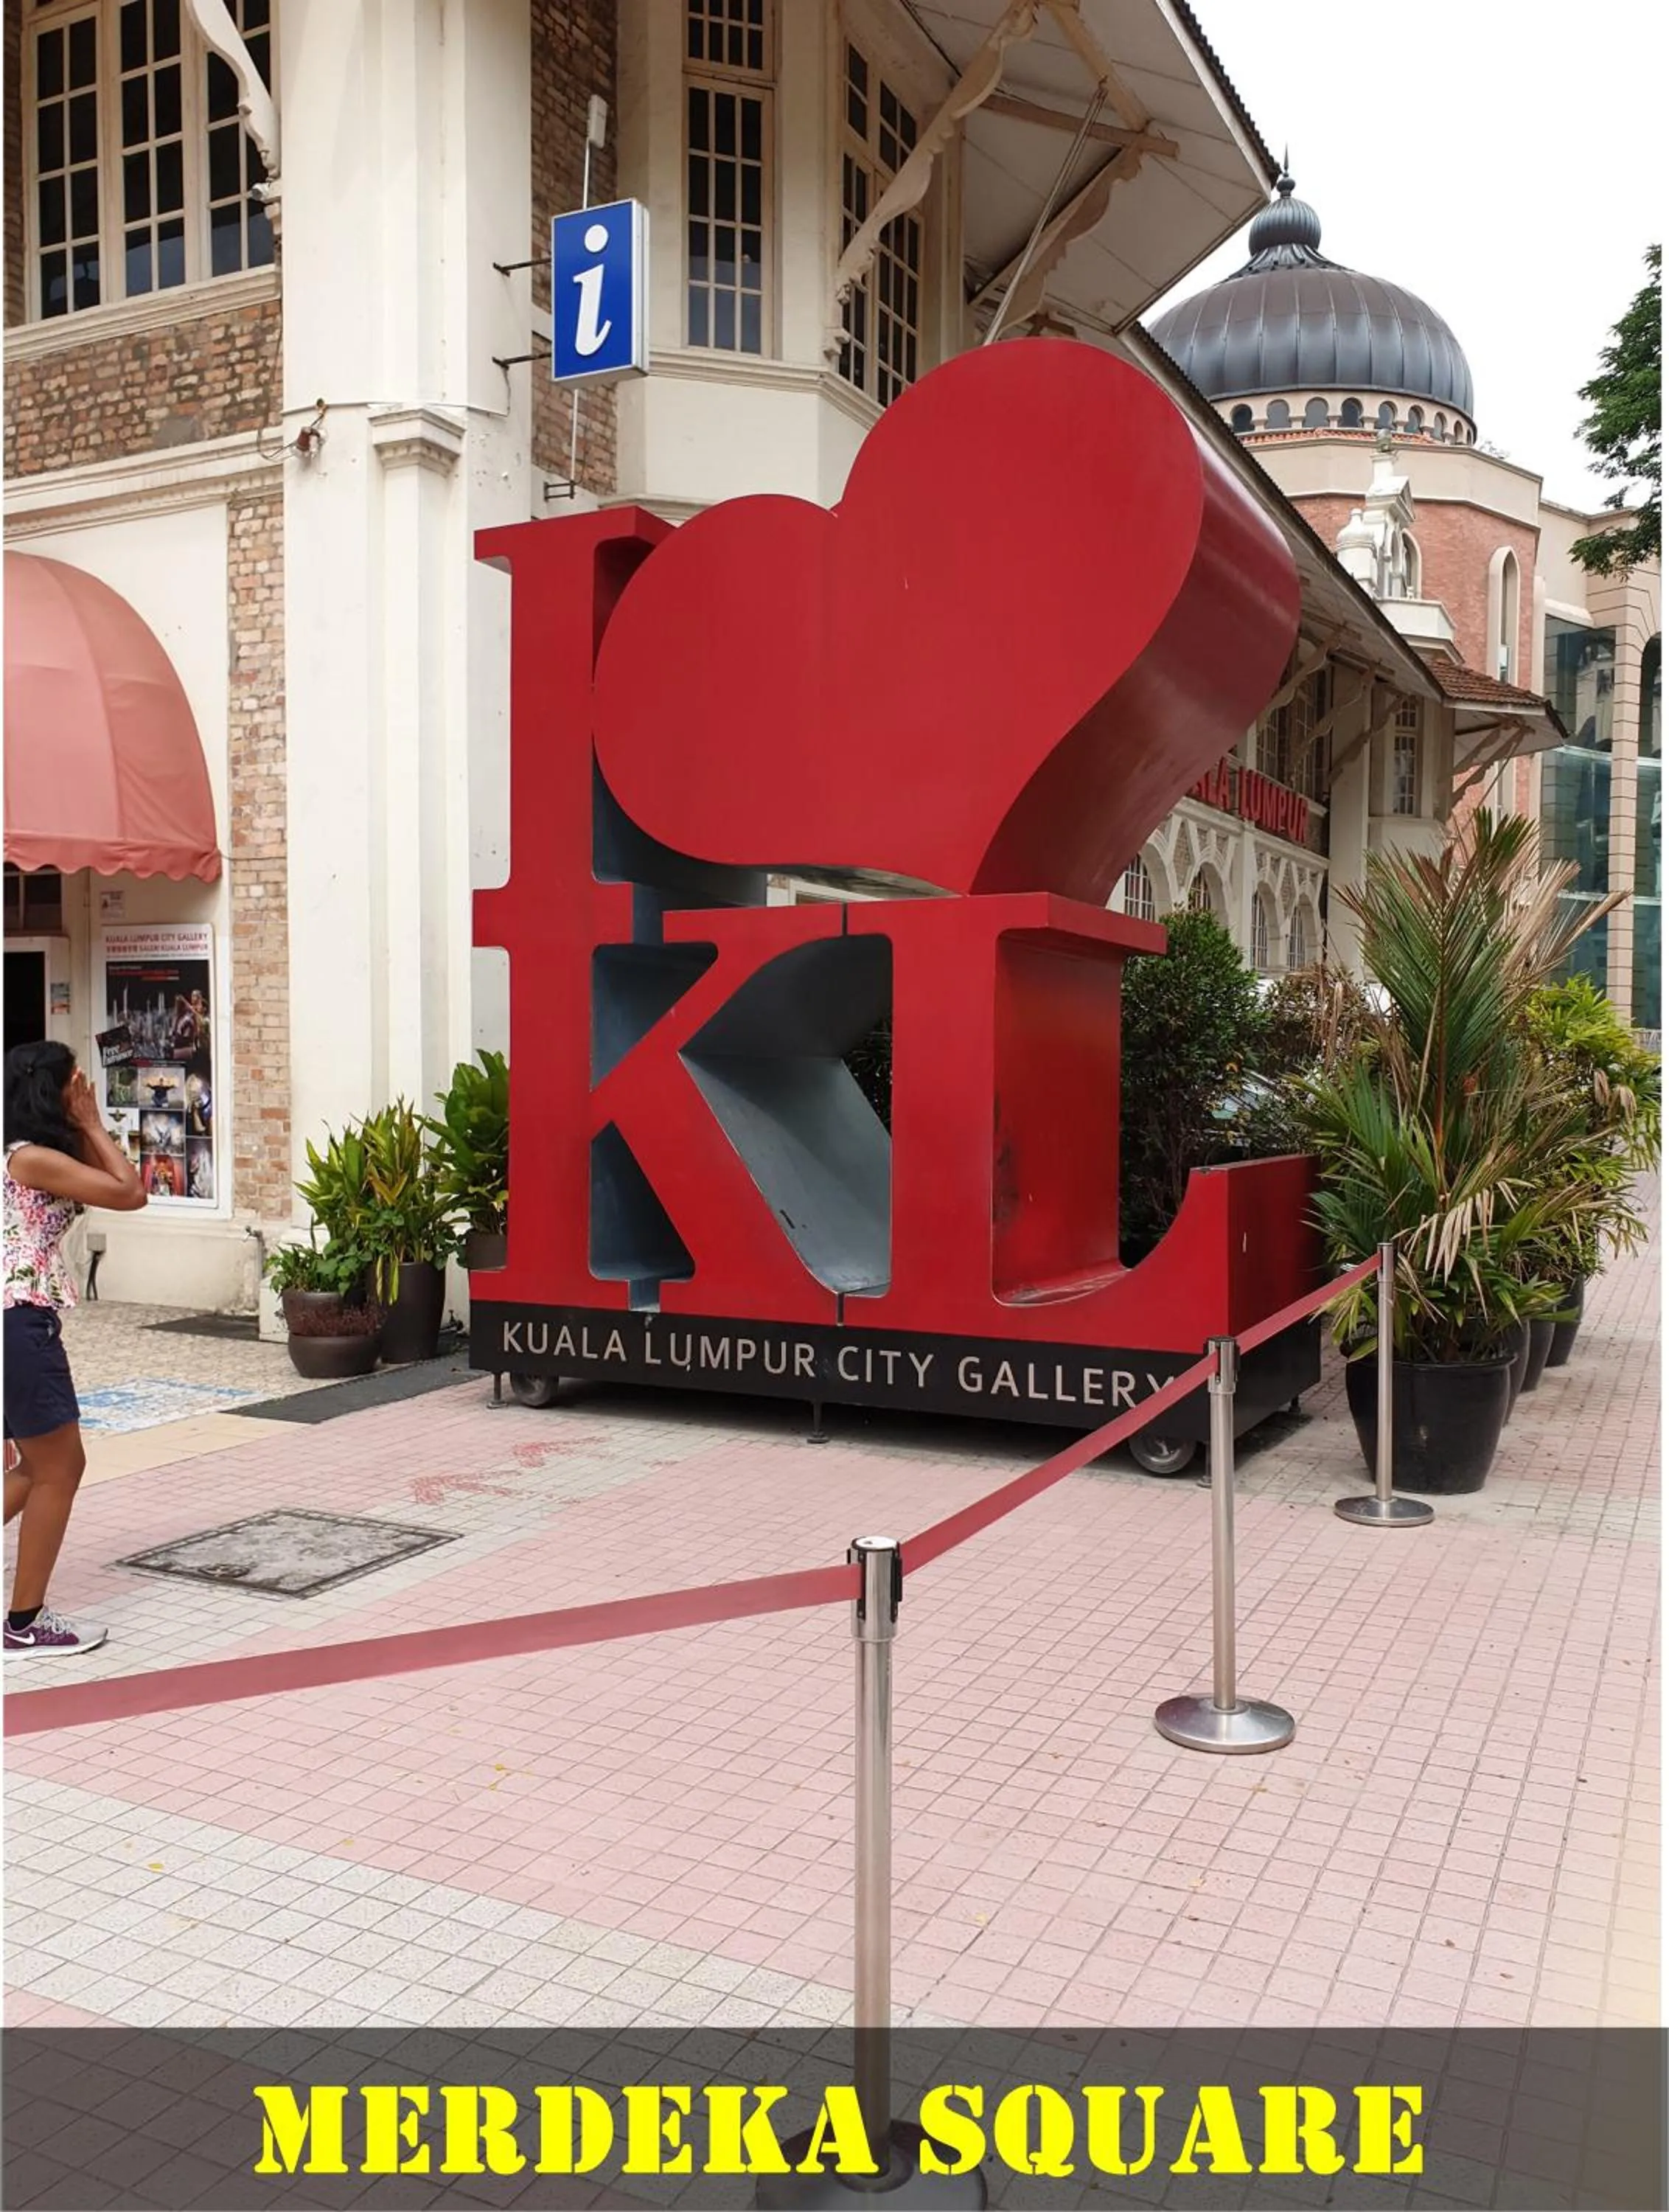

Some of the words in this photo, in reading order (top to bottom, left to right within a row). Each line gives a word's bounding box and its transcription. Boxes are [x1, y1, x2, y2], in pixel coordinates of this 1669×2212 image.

[1238, 766, 1309, 846] LUMPUR
[161, 933, 175, 942] CITY
[177, 932, 209, 942] GALLERY
[503, 1321, 627, 1363] KUALA
[644, 1331, 816, 1378] LUMPUR
[837, 1345, 934, 1388] CITY
[958, 1355, 1175, 1408] GALLERY
